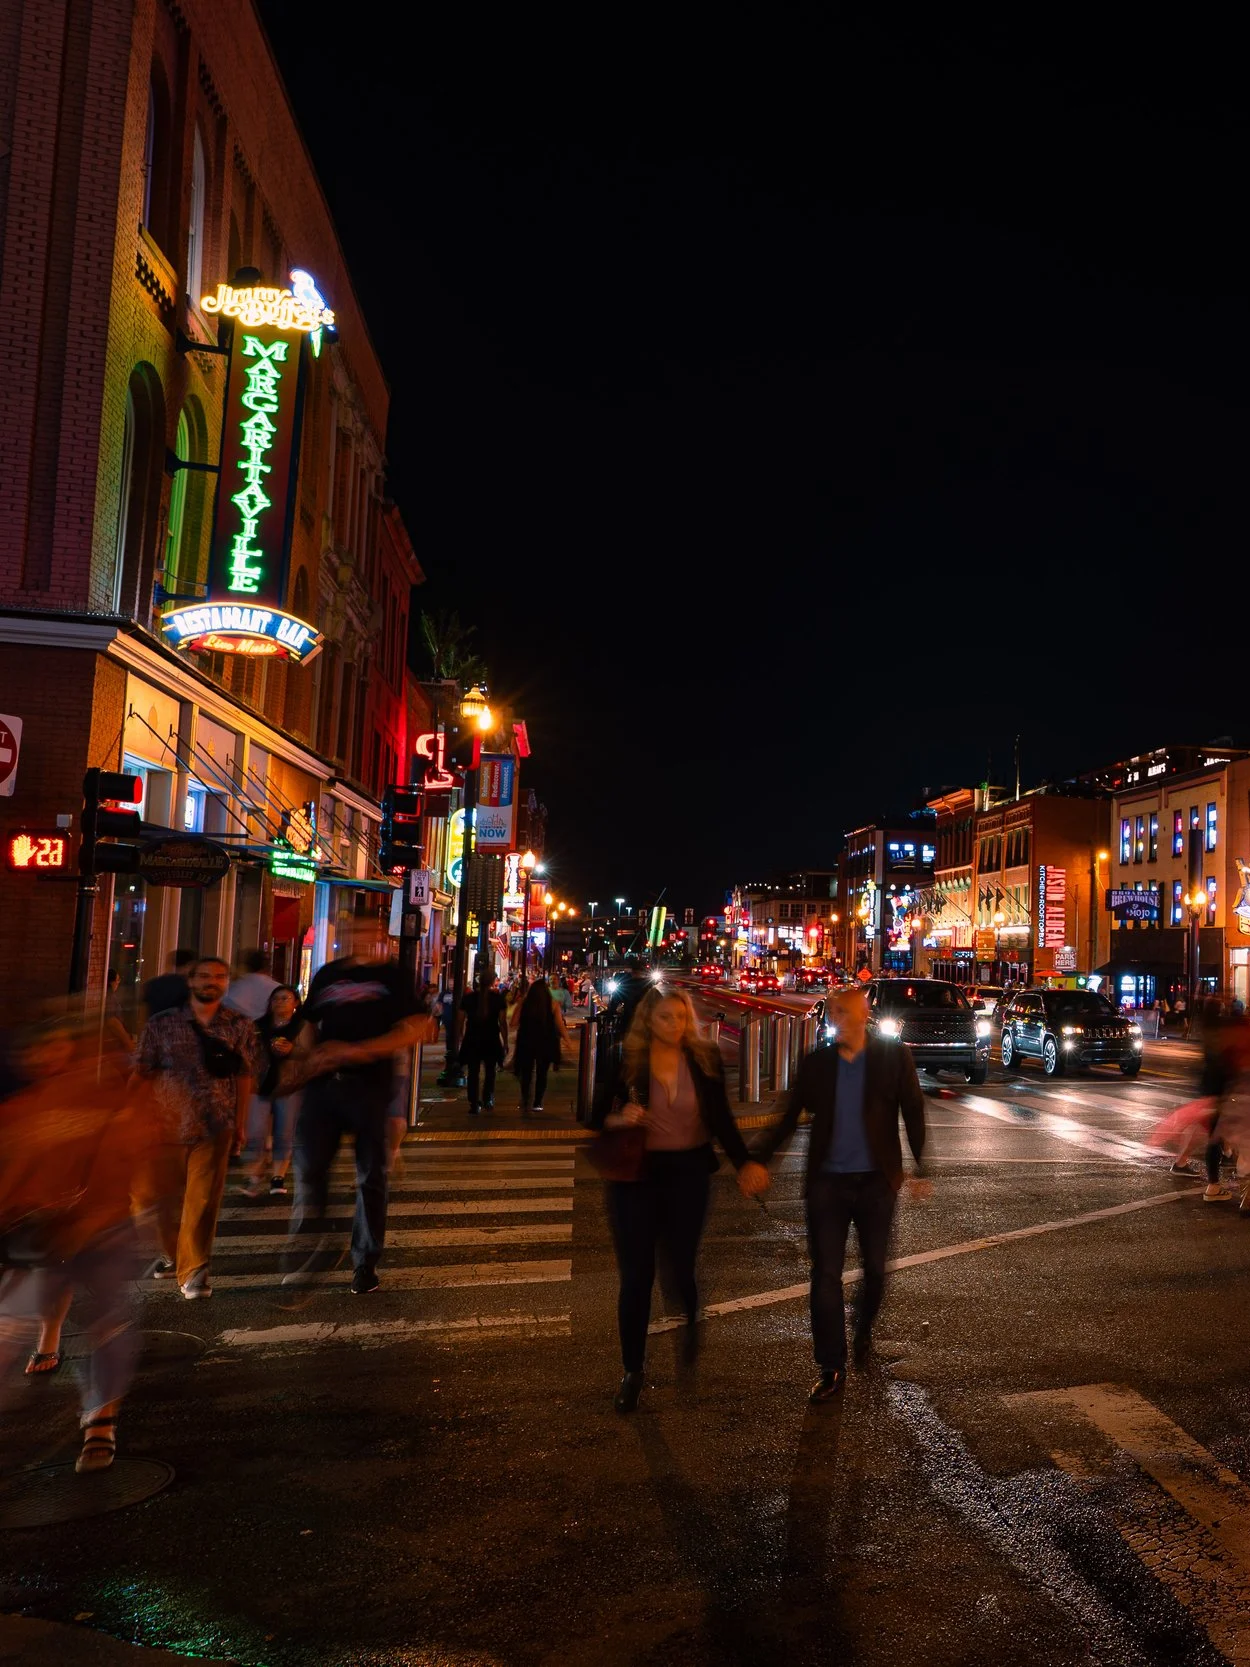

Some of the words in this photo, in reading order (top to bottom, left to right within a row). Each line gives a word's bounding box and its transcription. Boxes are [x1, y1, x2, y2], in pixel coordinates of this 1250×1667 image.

[200, 283, 293, 313] Jimmy
[228, 334, 290, 593] MARGARITAVILLE
[173, 606, 273, 637] RESTAURANT
[276, 618, 310, 649] BAR
[236, 639, 278, 653] Music
[501, 765, 510, 799] Reconnect.
[479, 829, 506, 838] NOW
[1045, 865, 1066, 901] JASON
[1111, 894, 1160, 908] BREWHOUSE
[1045, 906, 1065, 948] ALDEAN
